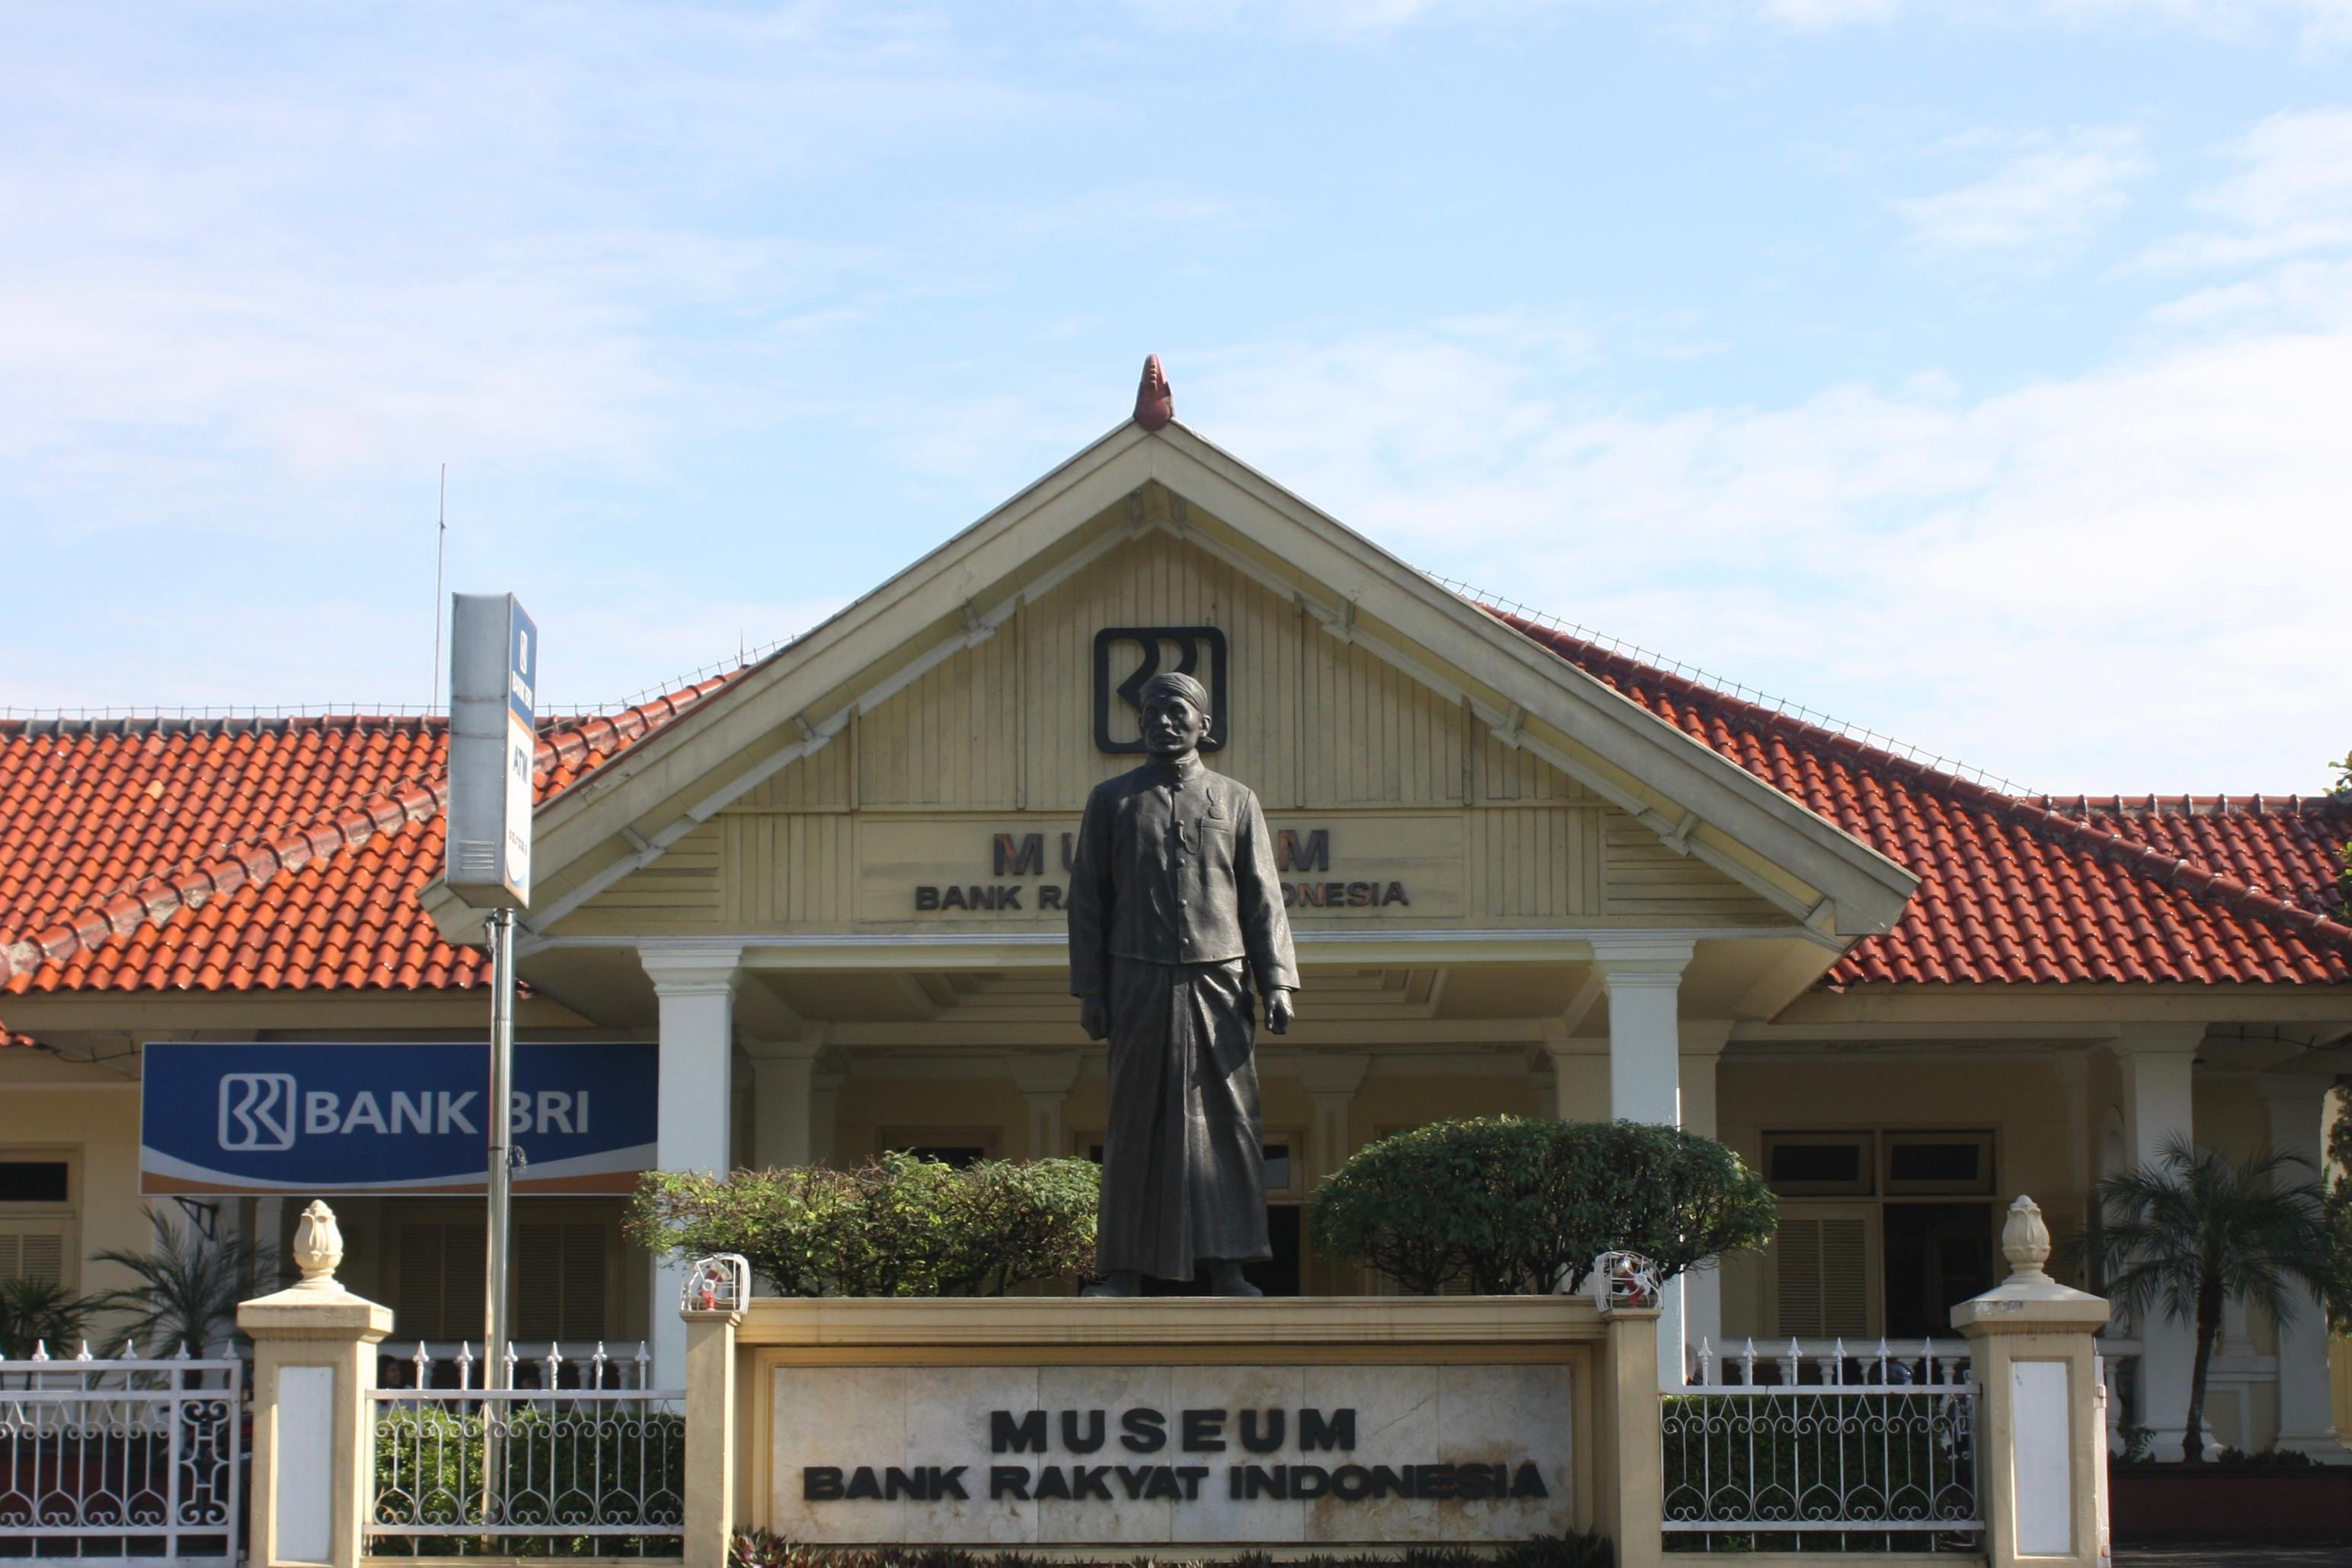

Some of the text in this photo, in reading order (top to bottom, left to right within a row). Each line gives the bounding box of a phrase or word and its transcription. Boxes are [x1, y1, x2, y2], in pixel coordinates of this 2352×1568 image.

[513, 743, 528, 784] ATM
[915, 886, 1022, 911] BANK
[1280, 880, 1409, 908] ONESIA
[305, 1090, 589, 1135] BANK BRI
[989, 1407, 1357, 1453] MUSEUM
[803, 1462, 1549, 1501] BANK RAKYAT INDONESIA
